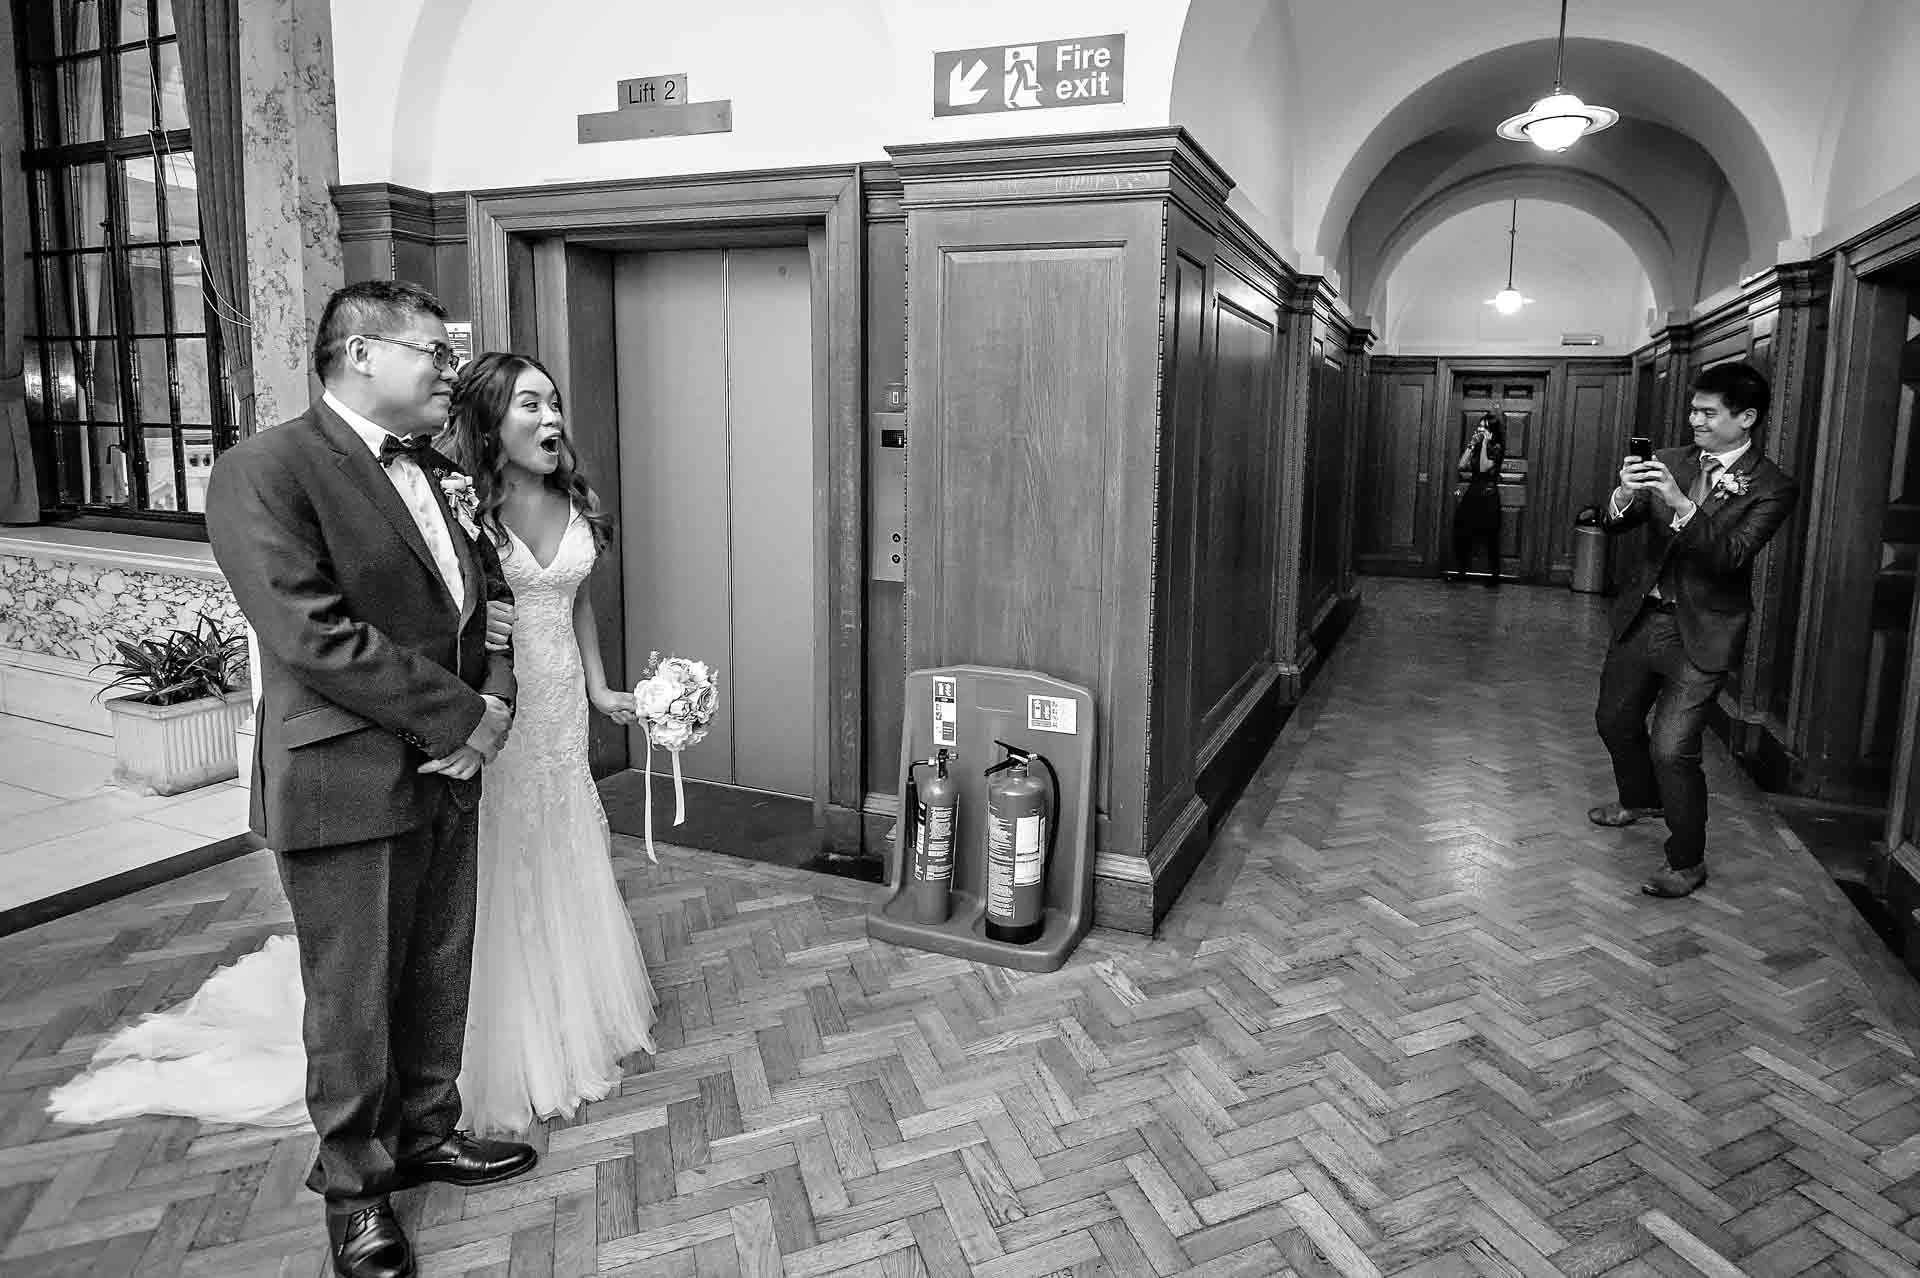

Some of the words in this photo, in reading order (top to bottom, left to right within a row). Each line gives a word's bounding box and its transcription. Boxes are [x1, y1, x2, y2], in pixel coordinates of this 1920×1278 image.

[1056, 44, 1111, 72] Fire
[628, 82, 656, 105] Lift
[664, 80, 676, 100] 2
[1056, 71, 1110, 101] exit
